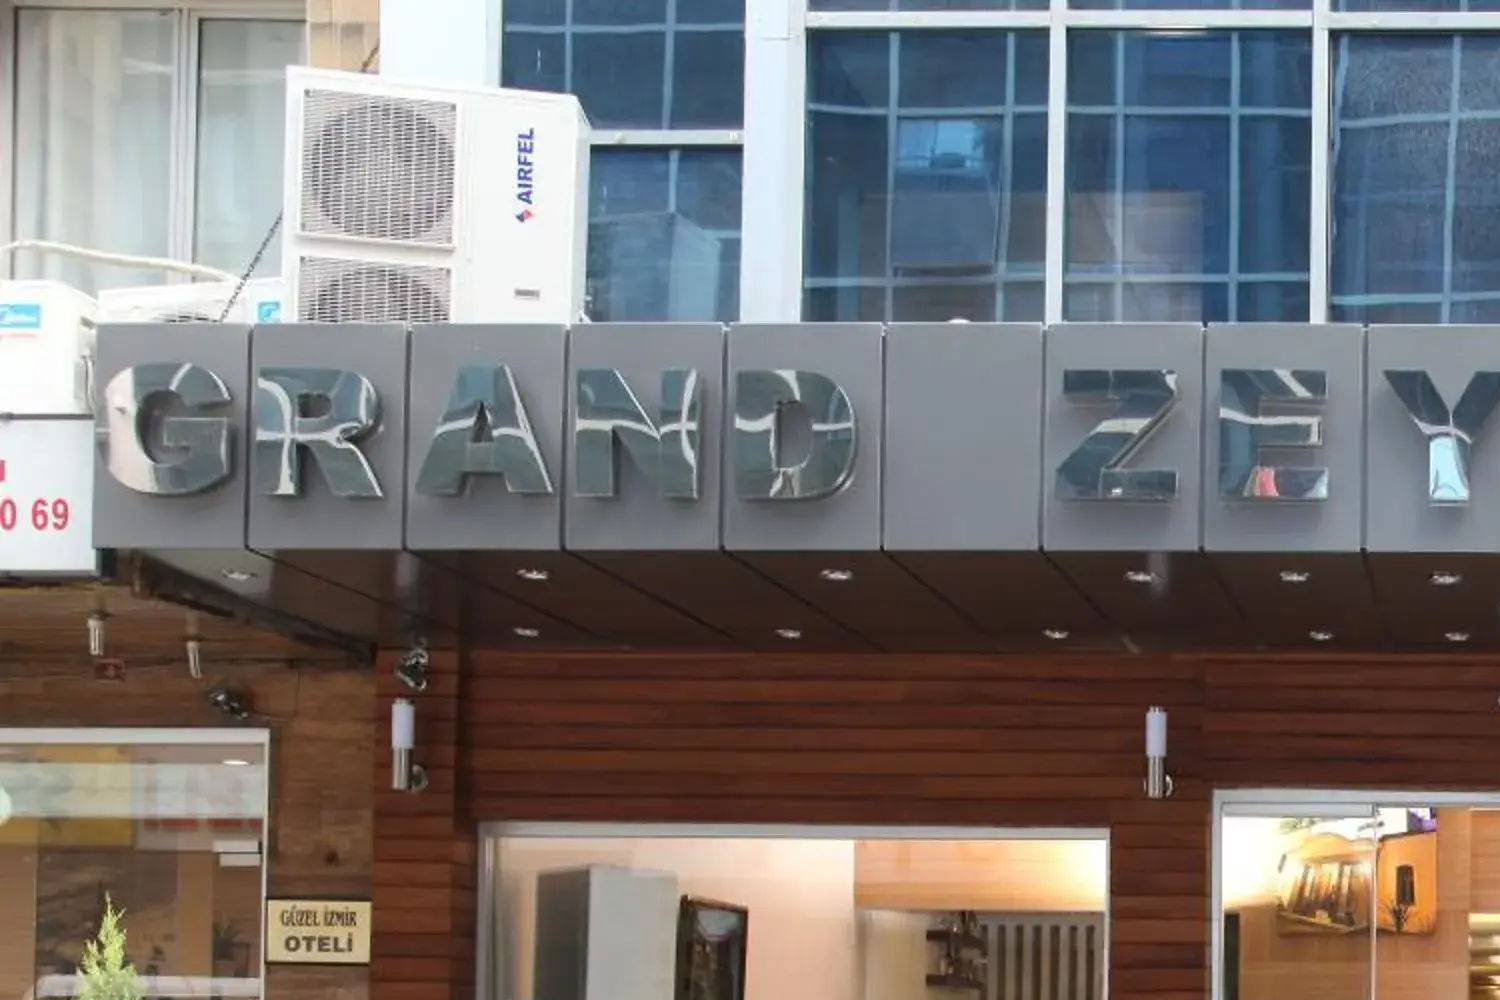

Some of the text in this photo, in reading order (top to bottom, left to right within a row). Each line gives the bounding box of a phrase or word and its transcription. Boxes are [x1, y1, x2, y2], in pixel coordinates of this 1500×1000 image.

[516, 128, 535, 205] AIRFEL
[103, 361, 857, 500] GRAND
[31, 498, 69, 530] 69
[284, 932, 354, 953] OTELİ
